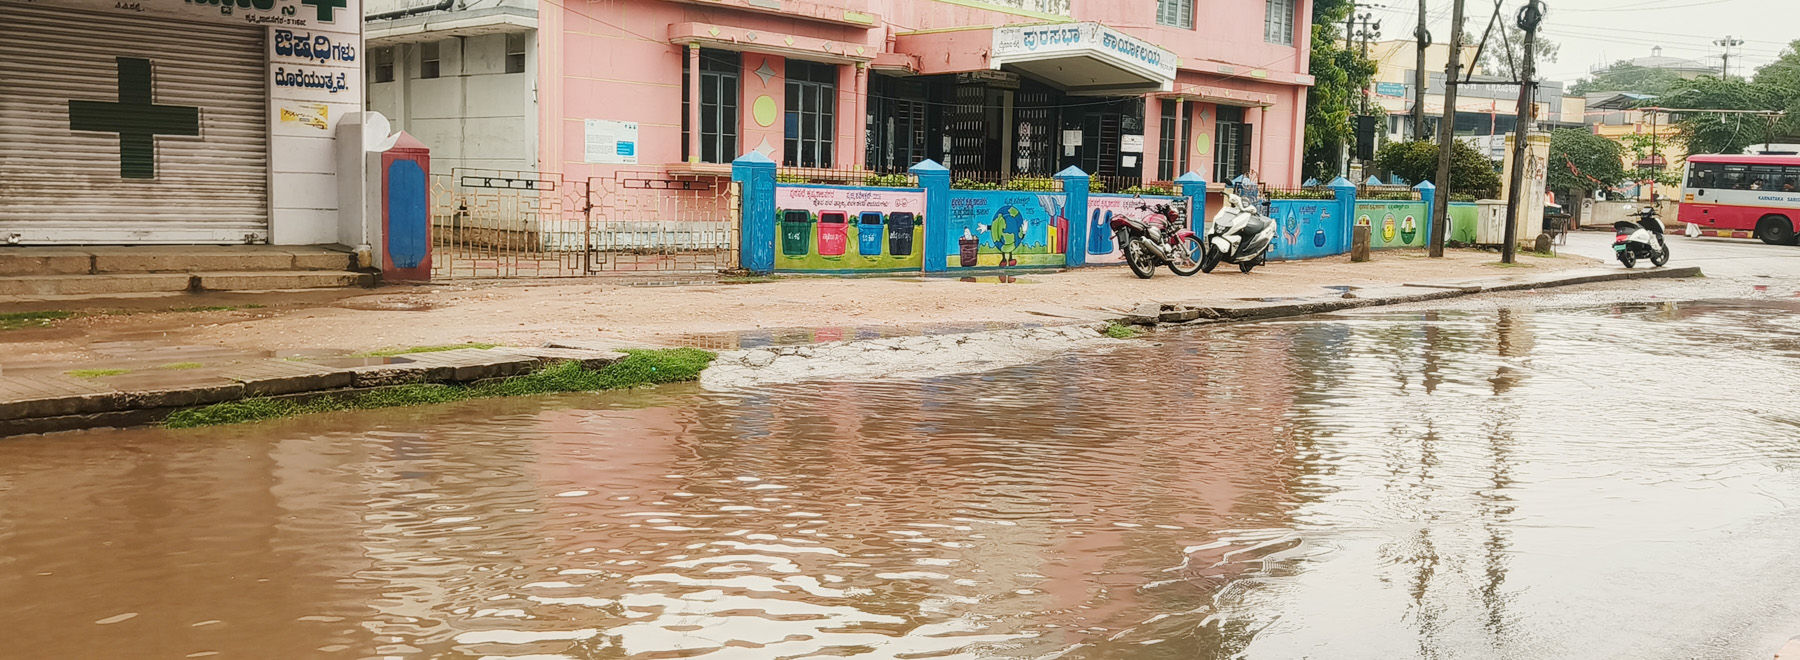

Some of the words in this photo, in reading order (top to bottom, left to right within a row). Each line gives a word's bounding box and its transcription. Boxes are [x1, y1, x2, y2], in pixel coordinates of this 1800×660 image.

[274, 28, 356, 64] ಔಷಧಿಗಳು
[1023, 26, 1081, 51] ಪುರಸಭಾ
[1102, 31, 1161, 66] ಕಾರ್ಯಾಲಯ
[274, 66, 349, 93] ದೊರೆಯುತ್ತವೆ.
